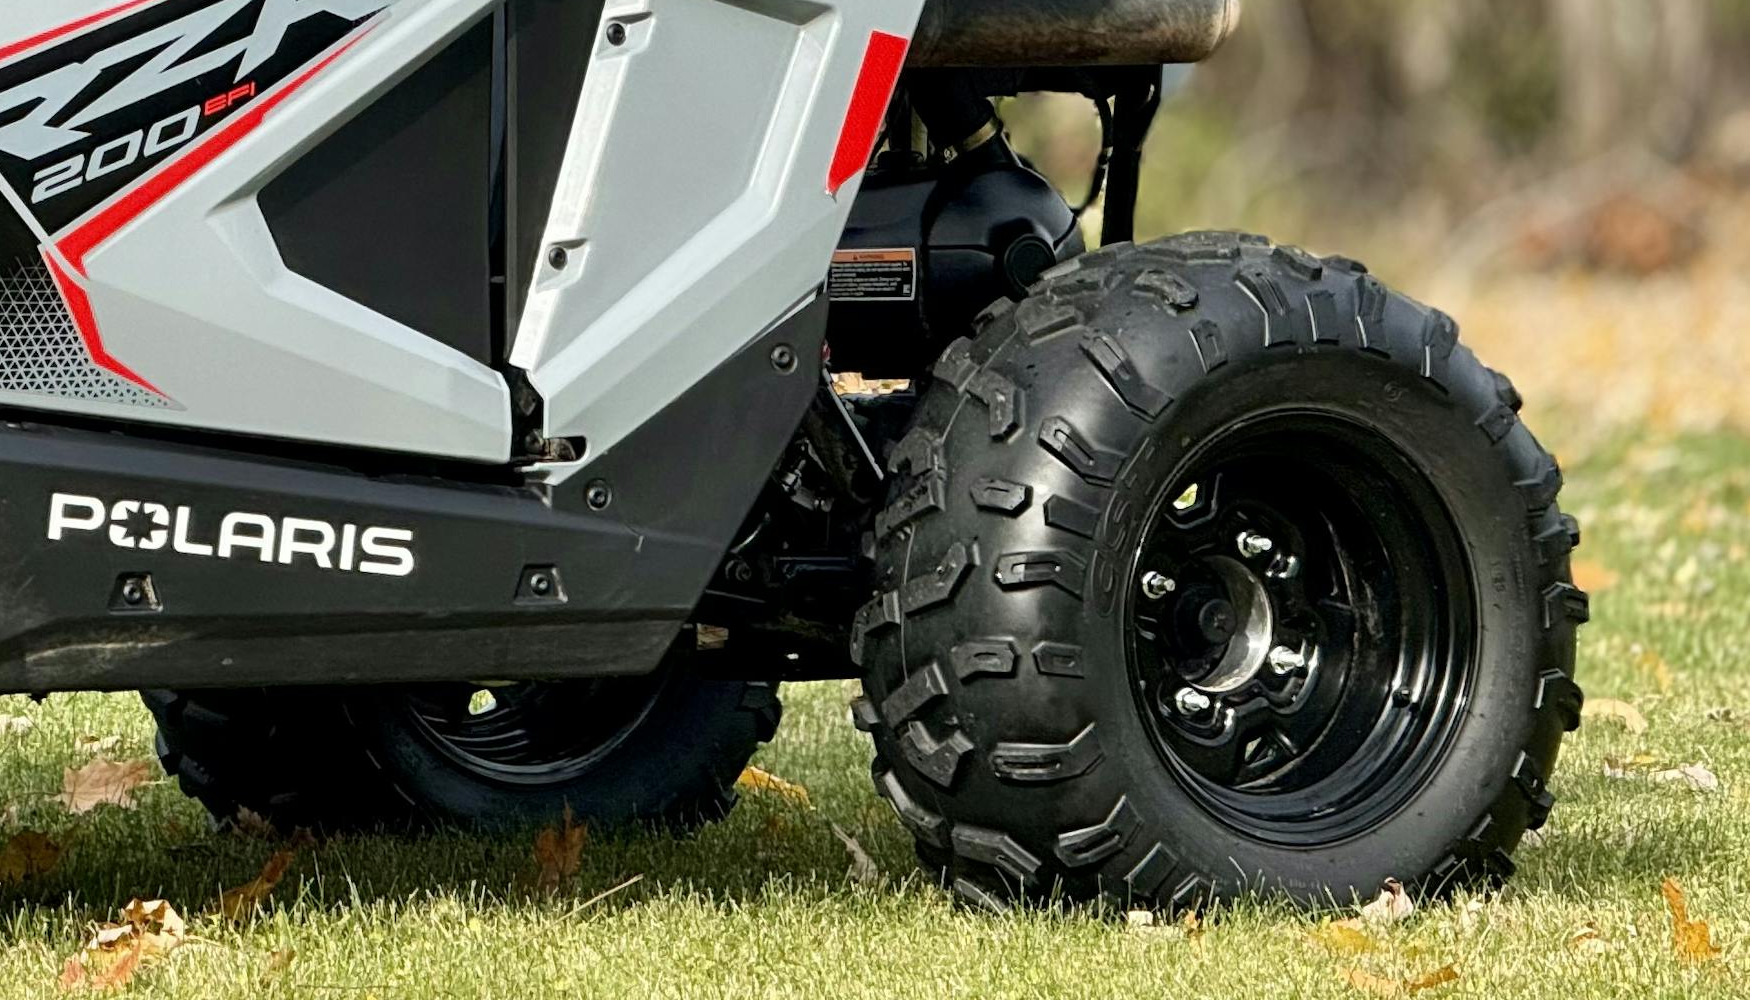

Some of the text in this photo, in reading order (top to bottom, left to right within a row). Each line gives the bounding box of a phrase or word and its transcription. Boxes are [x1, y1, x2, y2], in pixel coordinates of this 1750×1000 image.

[31, 81, 256, 204] 200 EFI
[47, 492, 415, 577] POLARIS
